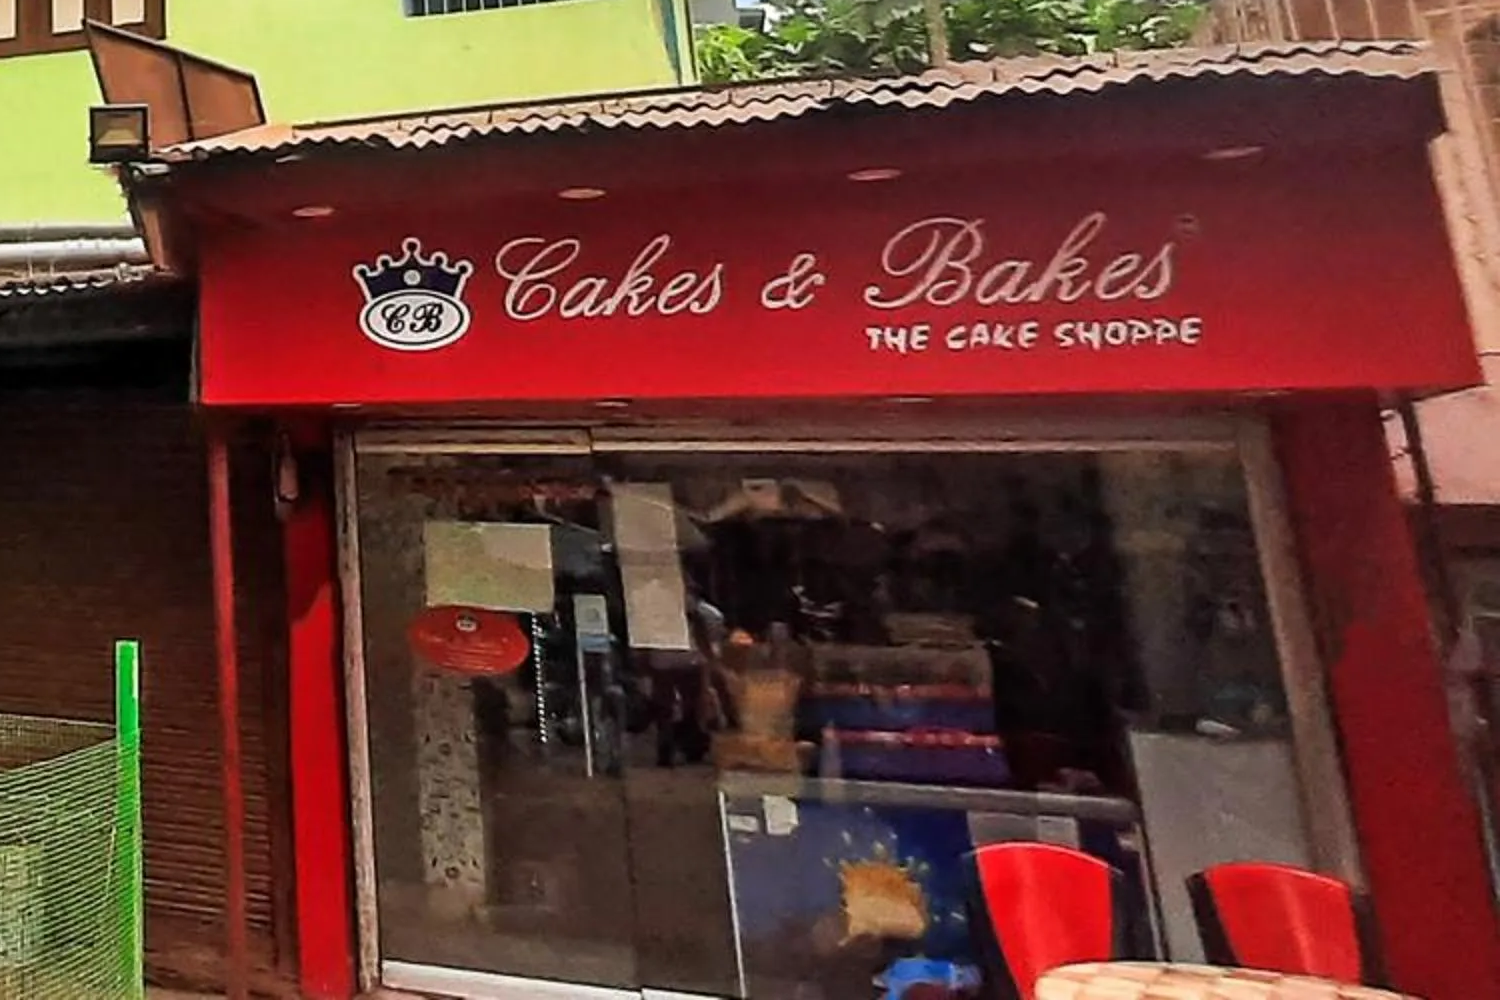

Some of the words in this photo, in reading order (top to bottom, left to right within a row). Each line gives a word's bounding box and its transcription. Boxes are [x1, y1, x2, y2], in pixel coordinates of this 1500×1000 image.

[496, 233, 723, 320] Cakes
[761, 253, 826, 309] &
[864, 211, 1176, 309] Bakes
[866, 321, 932, 354] THE
[945, 321, 1039, 350] CAKE
[1054, 317, 1203, 350] SHOPPE
